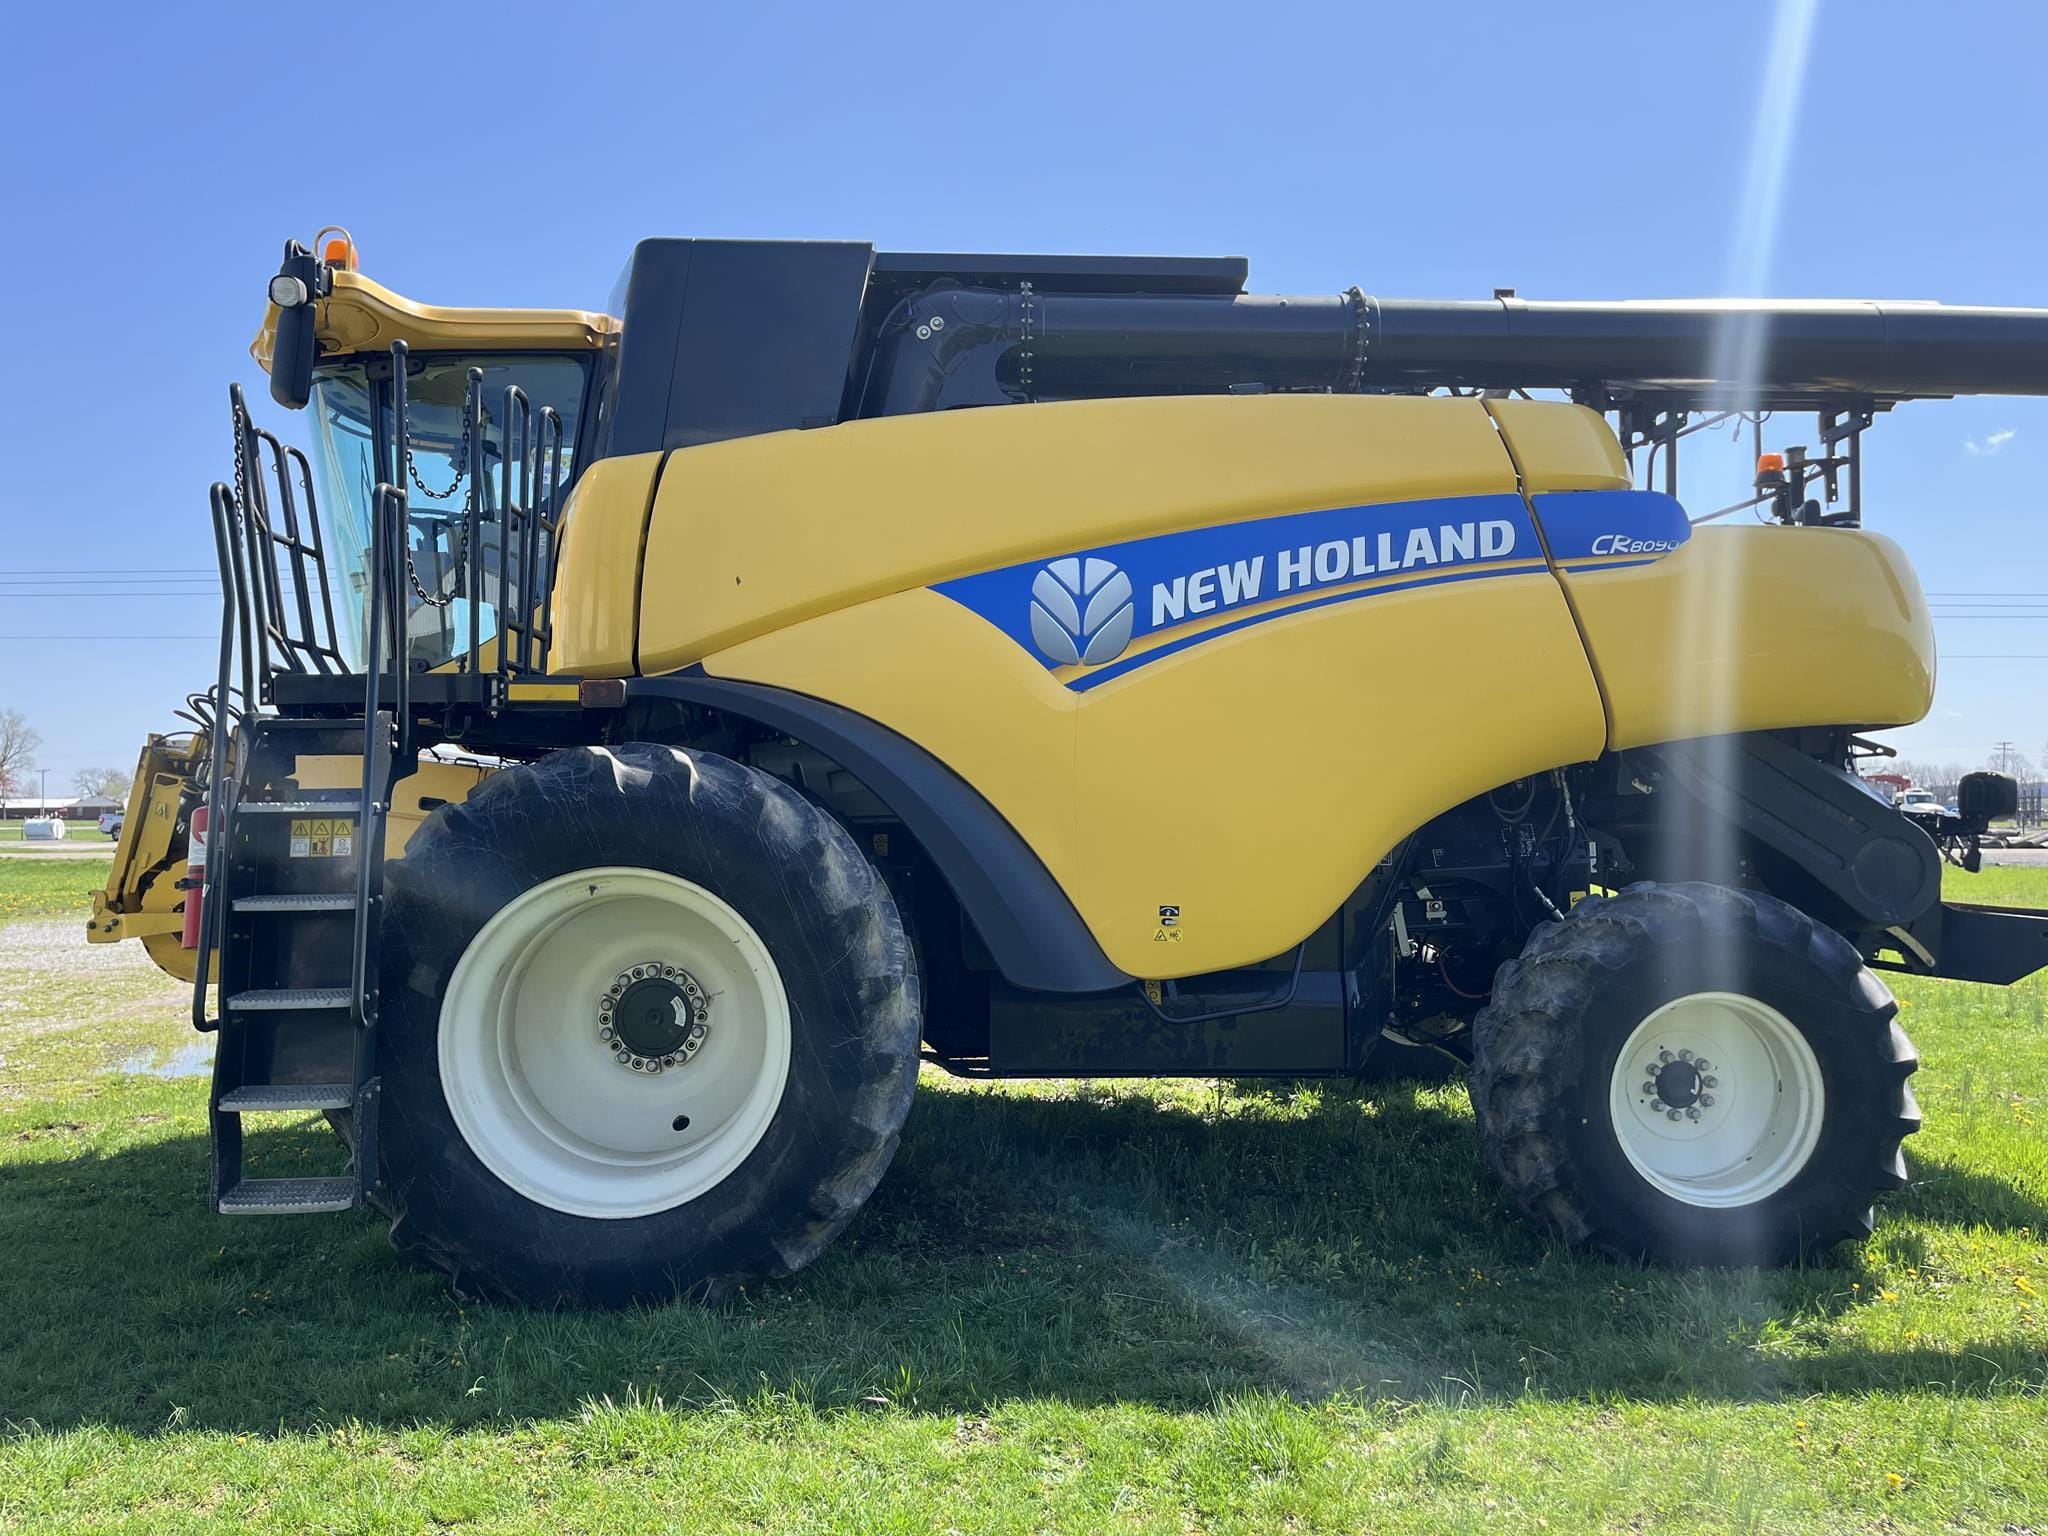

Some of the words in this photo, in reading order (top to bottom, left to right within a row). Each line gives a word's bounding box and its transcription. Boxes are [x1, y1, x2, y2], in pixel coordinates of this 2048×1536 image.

[1151, 555, 1265, 628] NEW
[1277, 519, 1517, 593] HOLLAND
[1591, 534, 1680, 555] CR8090
